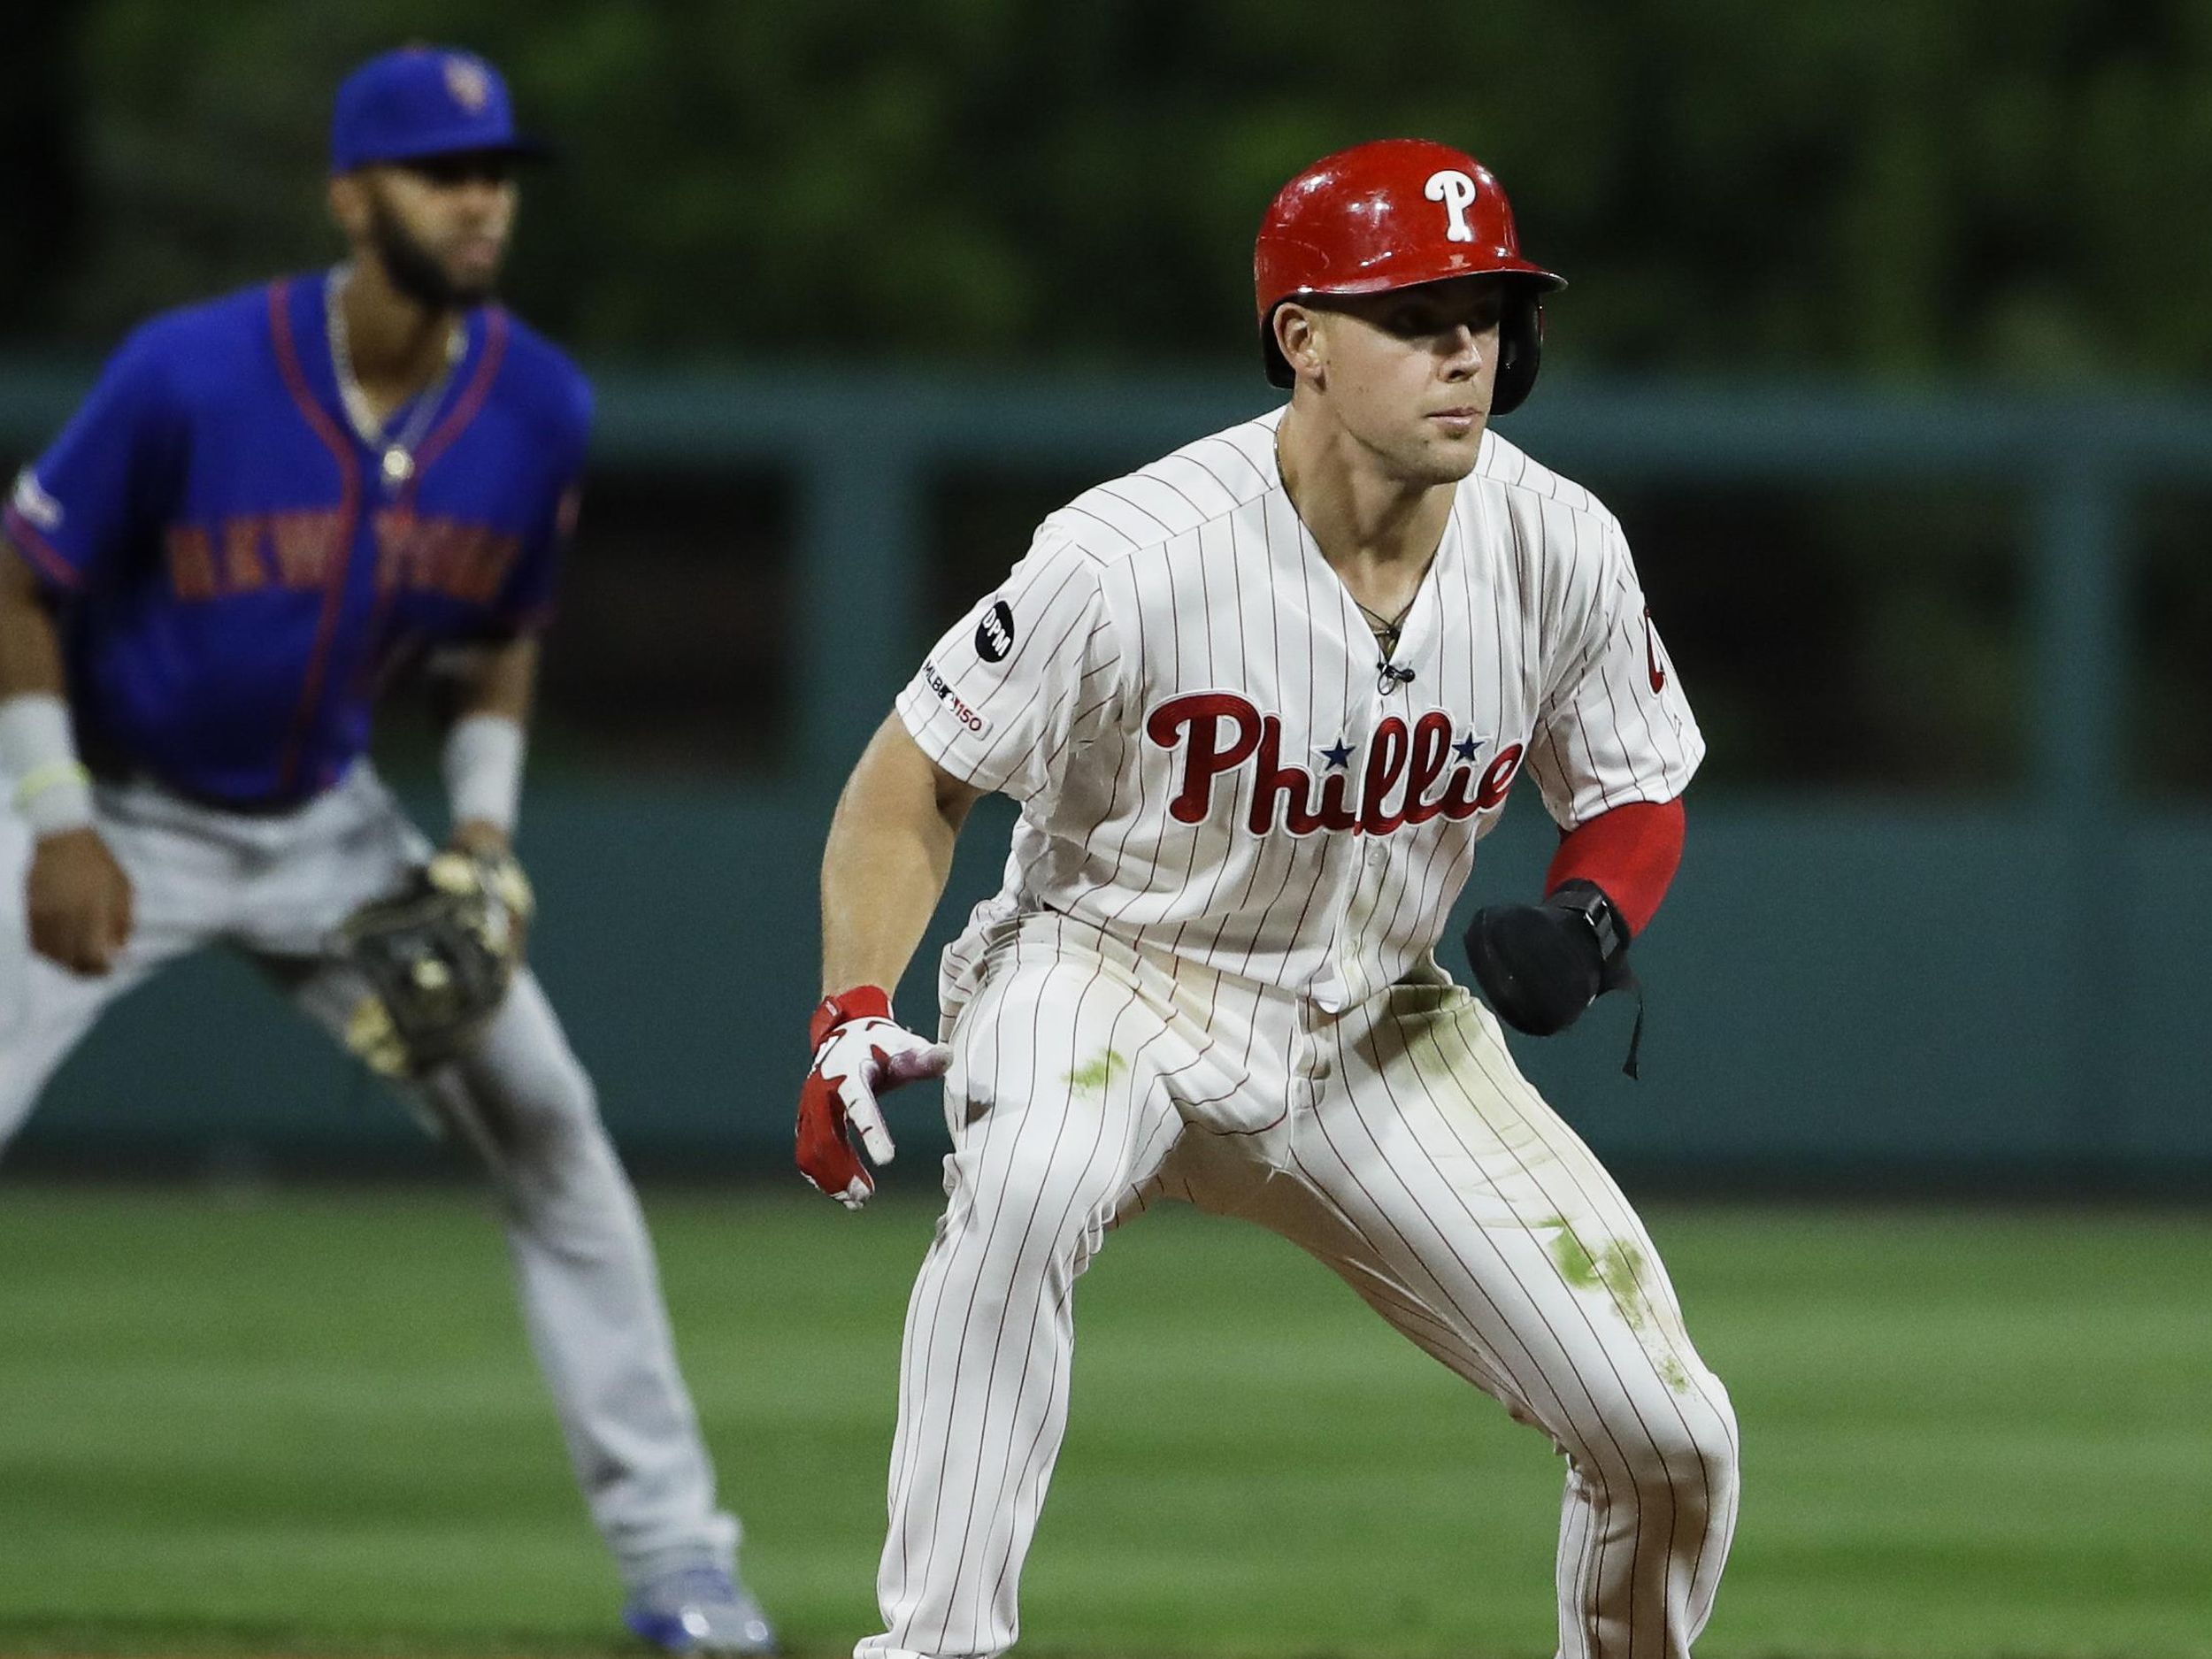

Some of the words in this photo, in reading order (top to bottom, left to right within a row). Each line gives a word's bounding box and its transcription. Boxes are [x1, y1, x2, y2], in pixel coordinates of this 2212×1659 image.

[1424, 169, 1477, 242] P
[982, 607, 1011, 657] DPM
[923, 659, 943, 692] MLB
[956, 704, 982, 732] 150
[1147, 693, 1524, 836] Phillie
